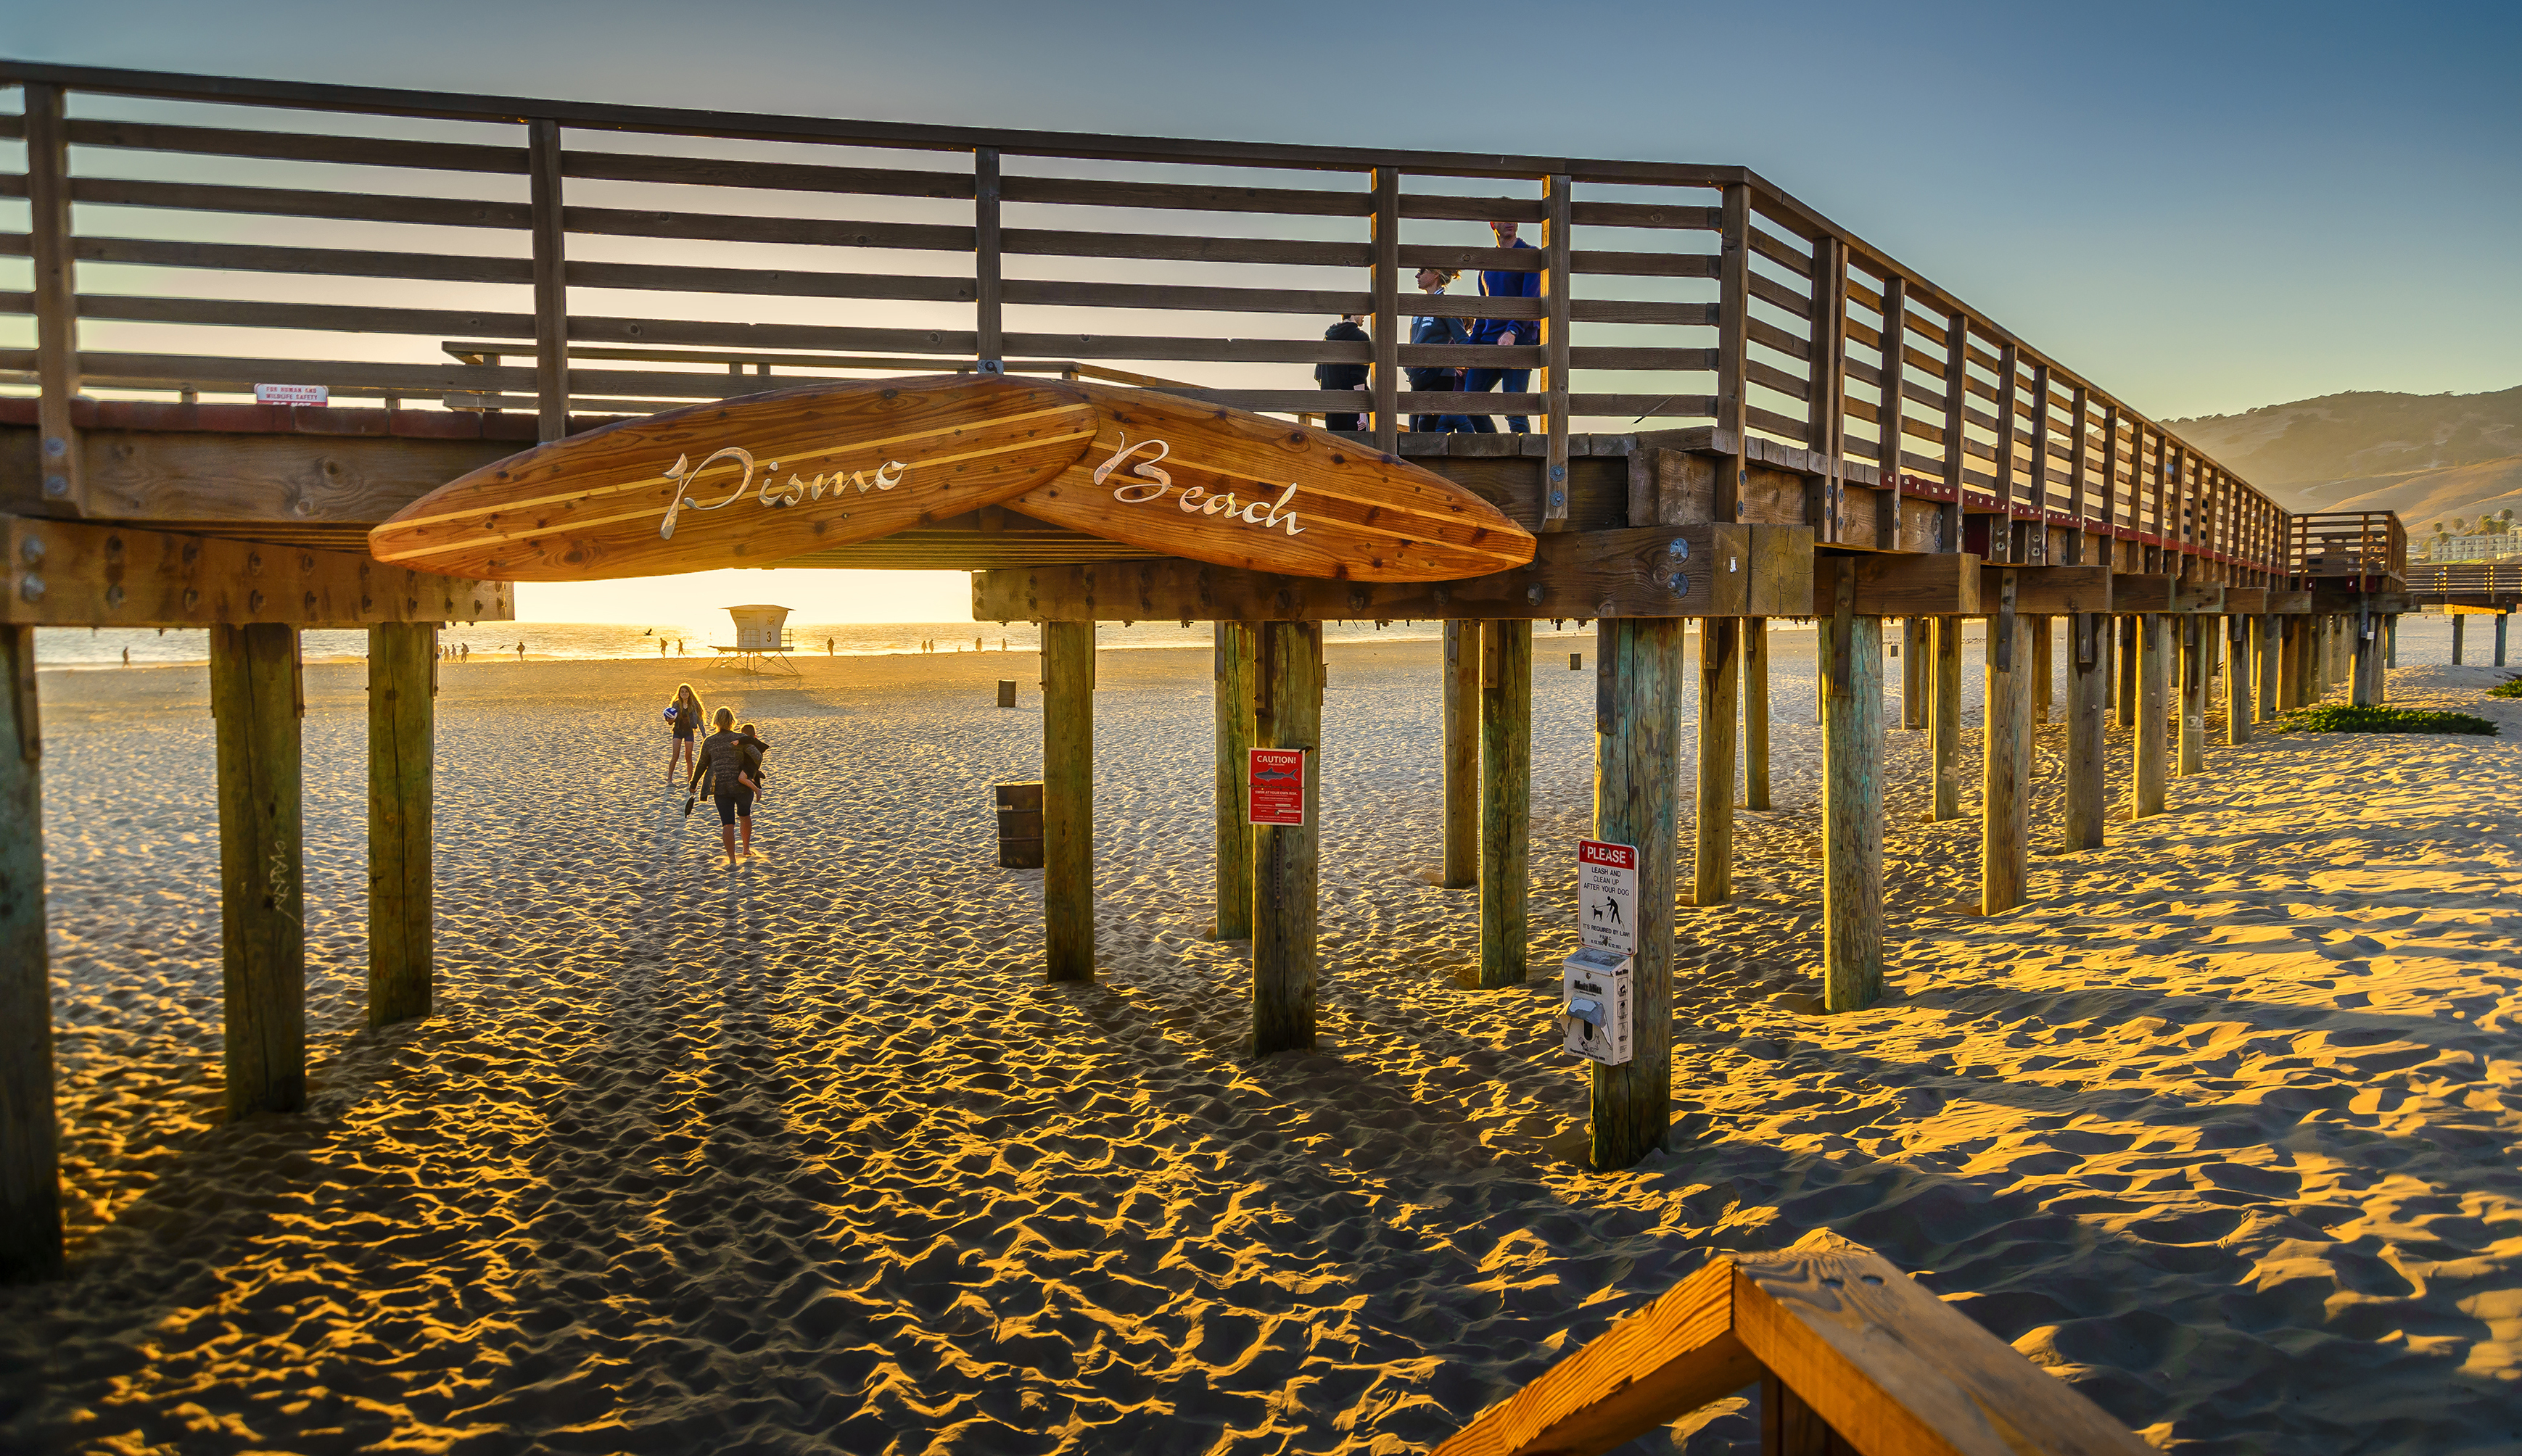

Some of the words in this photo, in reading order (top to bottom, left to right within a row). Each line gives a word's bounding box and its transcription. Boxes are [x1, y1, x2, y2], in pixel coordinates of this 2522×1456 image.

[659, 447, 907, 540] Pismo
[1093, 431, 1306, 536] Beach
[766, 631, 772, 642] 3
[1256, 755, 1297, 764] CAUTION!
[1587, 846, 1626, 864] PLEASE
[1593, 875, 1610, 884] CLEAN
[1591, 925, 1612, 934] REQUIRED
